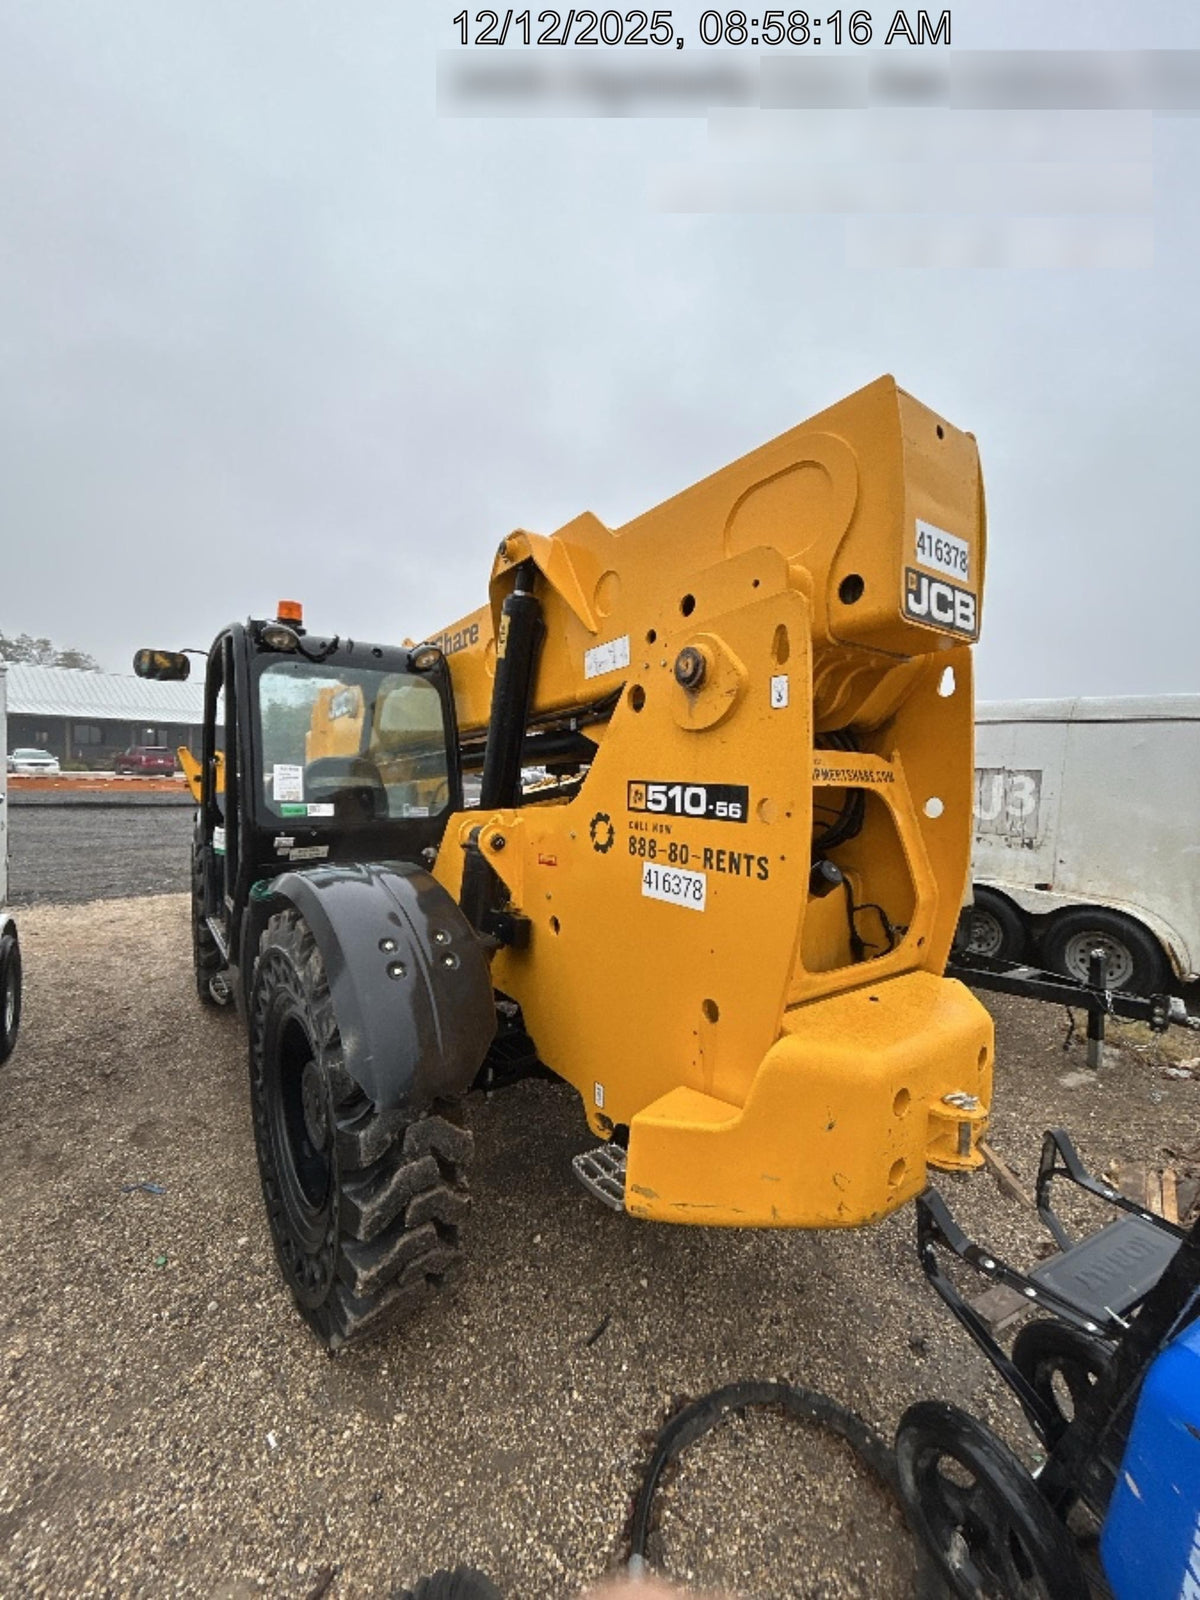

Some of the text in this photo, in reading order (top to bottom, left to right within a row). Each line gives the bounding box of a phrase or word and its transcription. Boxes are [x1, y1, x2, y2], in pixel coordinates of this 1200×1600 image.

[916, 530, 969, 574] 416378
[908, 577, 976, 631] JCB
[628, 835, 769, 881] 888-80-RENTS
[643, 869, 703, 901] 416378
